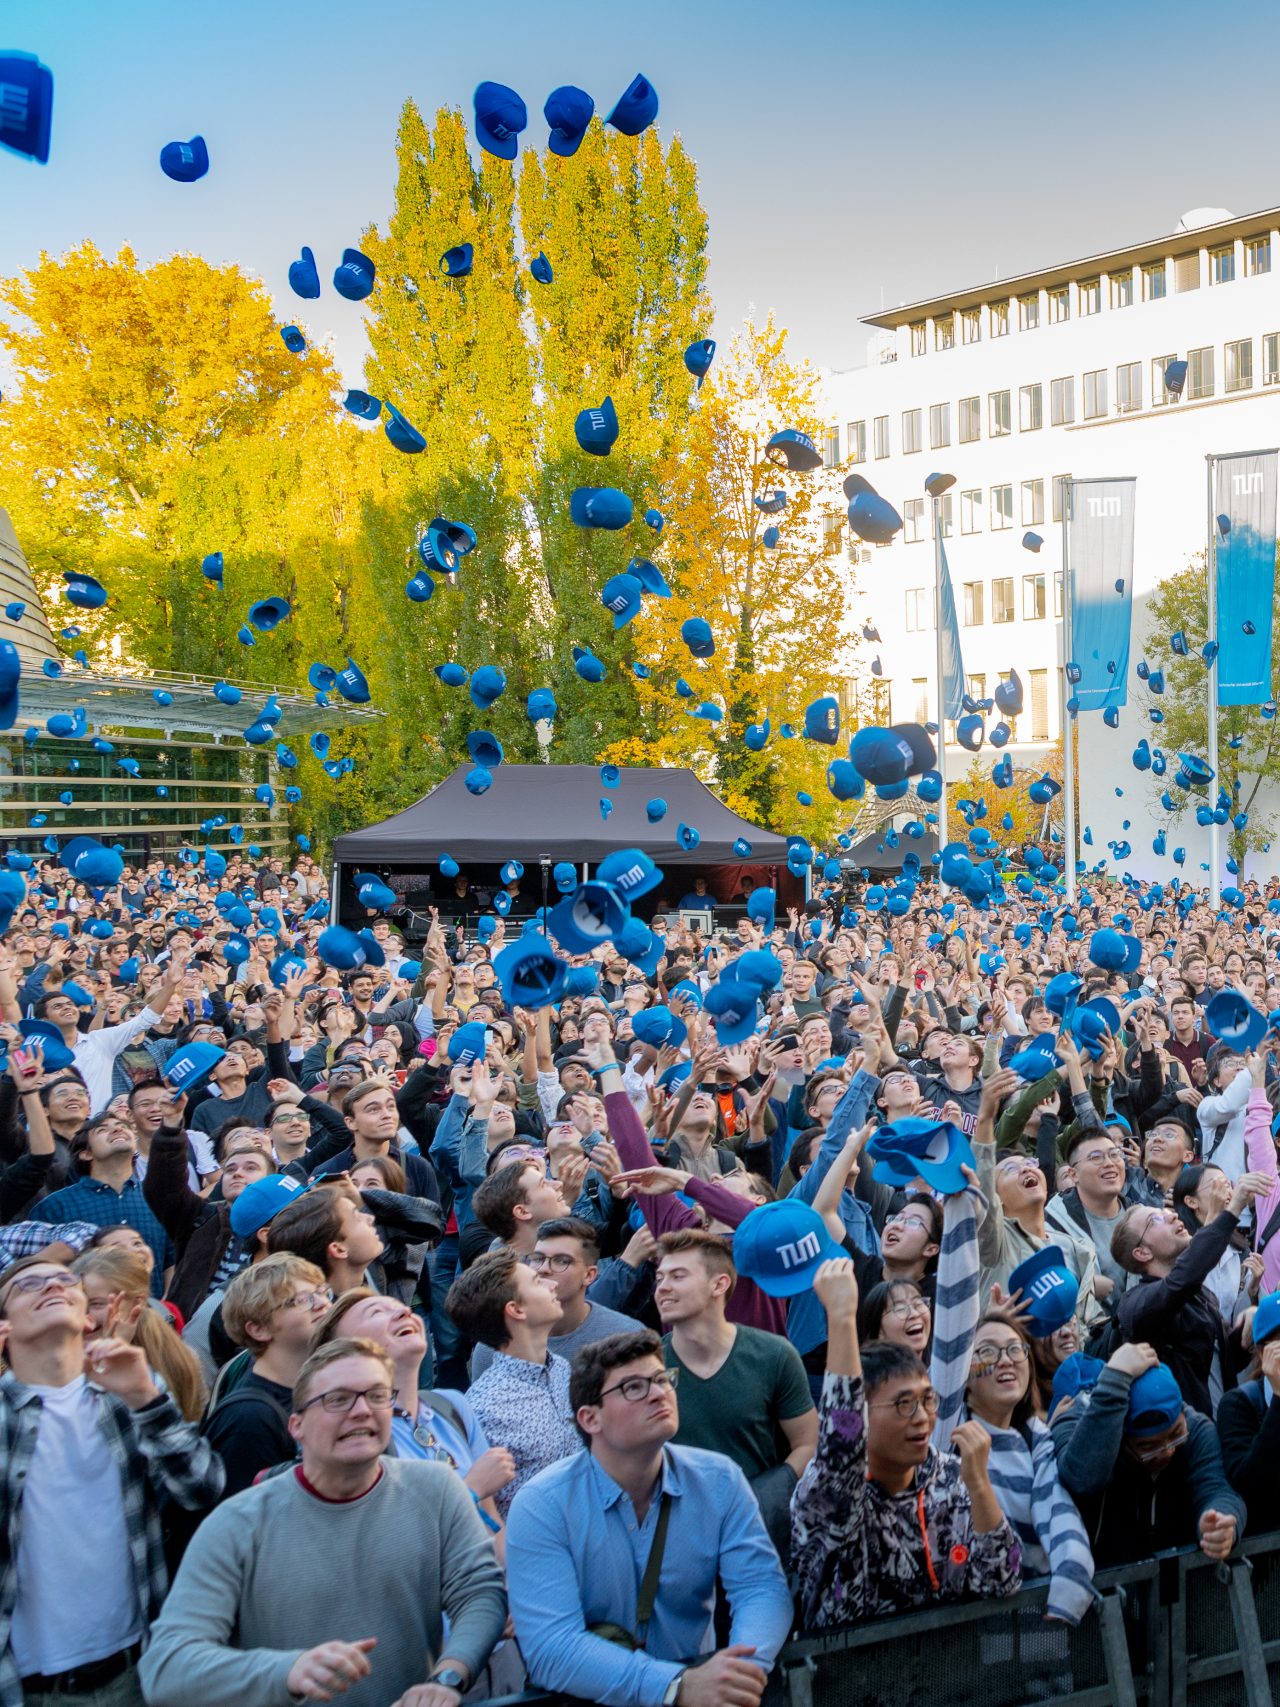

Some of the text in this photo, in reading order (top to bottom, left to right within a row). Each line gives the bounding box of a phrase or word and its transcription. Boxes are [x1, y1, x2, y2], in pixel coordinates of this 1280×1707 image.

[344, 262, 362, 275] TUM
[589, 410, 605, 430] TUM
[795, 433, 815, 451] TUM
[1231, 472, 1263, 495] TUM
[1087, 496, 1120, 516] TUM
[422, 541, 434, 560] TUM
[414, 579, 425, 590] TUM
[609, 596, 628, 612] TUM
[342, 670, 358, 685] TUM
[617, 864, 644, 889] TUM
[168, 1058, 196, 1082] TUM
[776, 1231, 820, 1270] TUM
[1029, 1269, 1064, 1299] TUM
